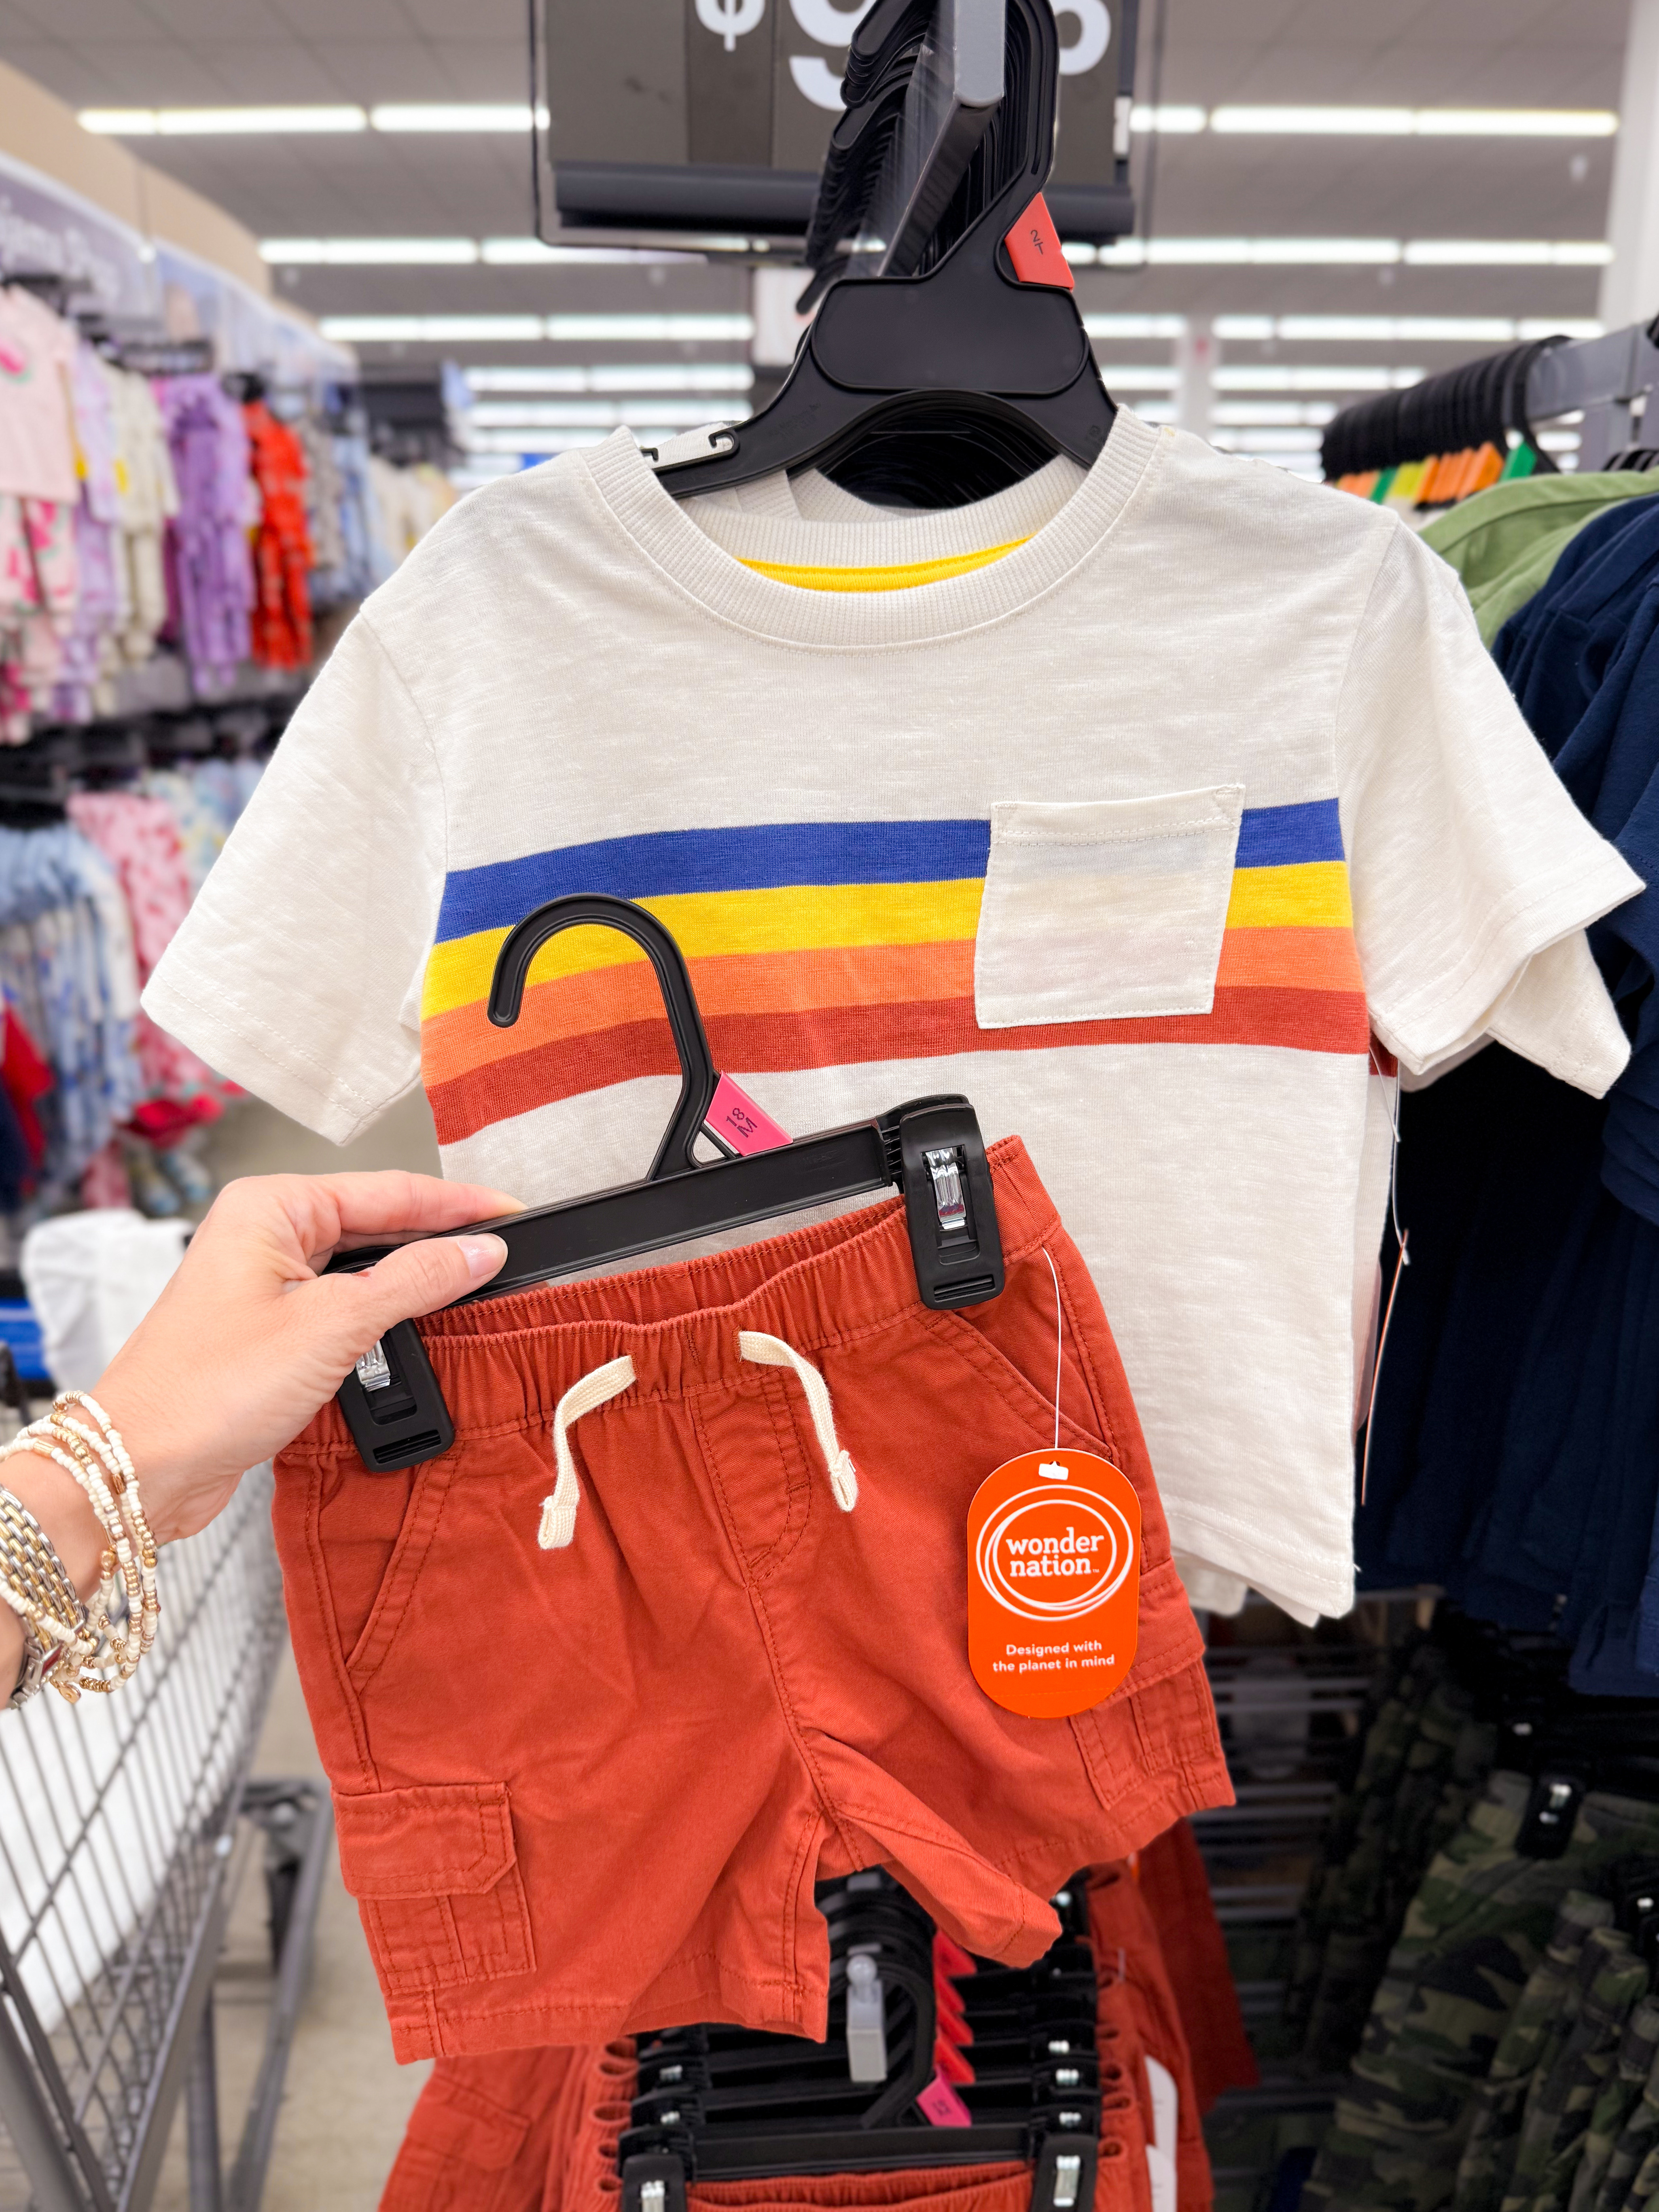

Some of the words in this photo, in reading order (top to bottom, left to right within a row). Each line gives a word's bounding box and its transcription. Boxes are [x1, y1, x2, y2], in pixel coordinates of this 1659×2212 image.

[1006, 1526, 1104, 1555] wonder
[1006, 1642, 1069, 1657] Designed
[1073, 1640, 1102, 1653] with
[993, 1660, 1015, 1672] the
[1019, 1659, 1061, 1674] planet
[1065, 1657, 1077, 1668] in
[1081, 1654, 1115, 1667] mind
